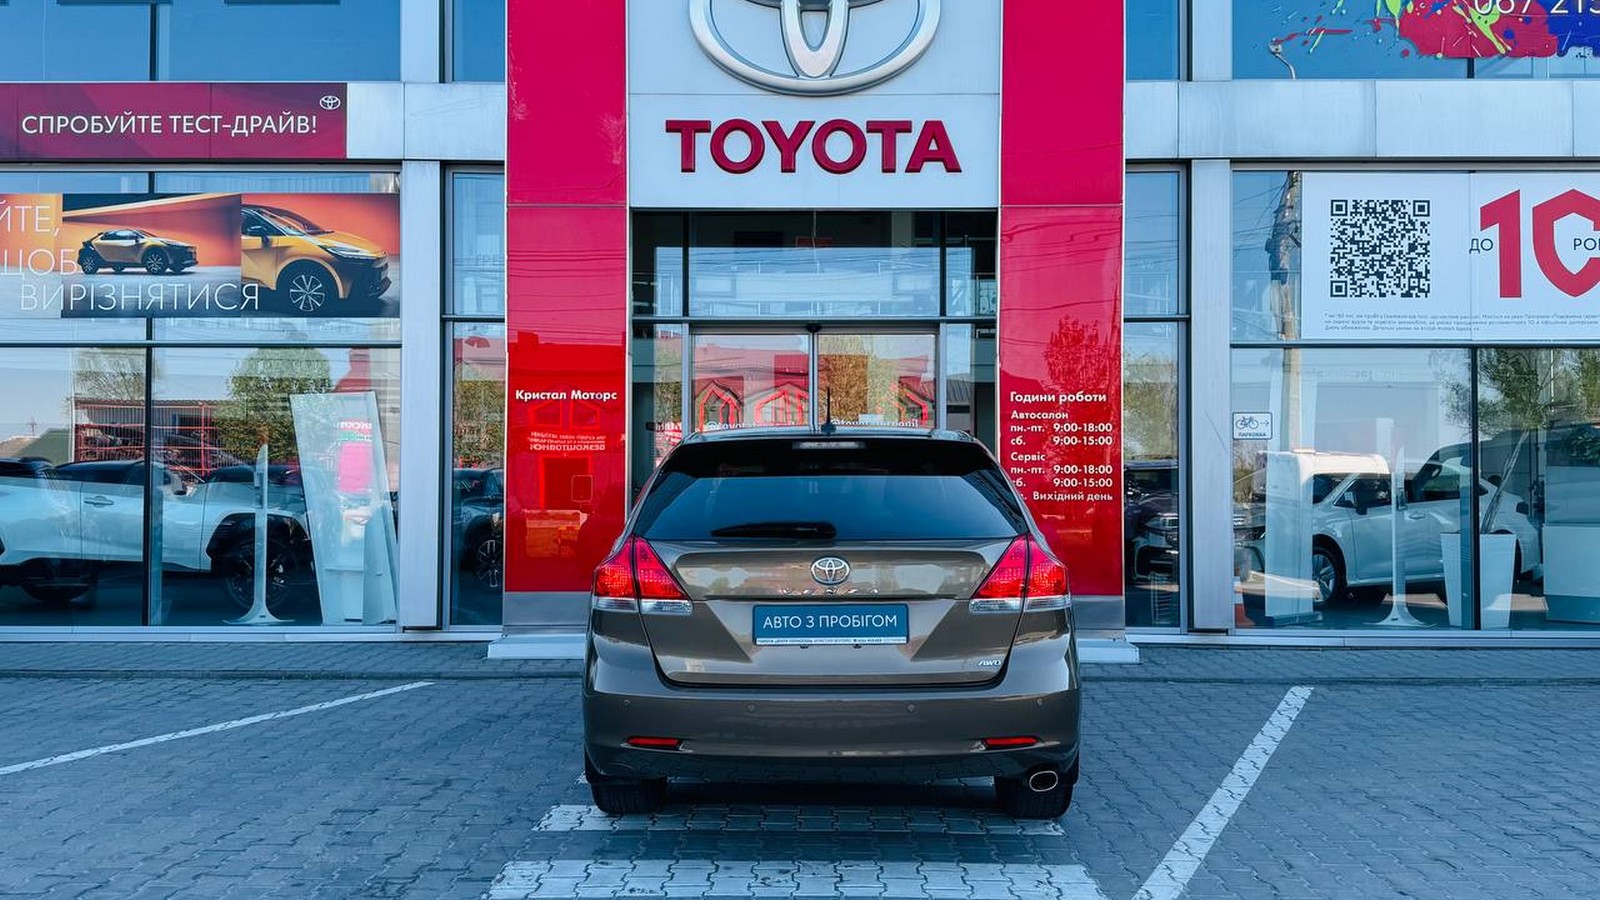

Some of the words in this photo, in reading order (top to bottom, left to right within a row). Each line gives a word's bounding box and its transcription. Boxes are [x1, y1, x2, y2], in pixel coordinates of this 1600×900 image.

[21, 111, 163, 134] СПРОБУЙТЕ
[169, 111, 317, 137] ТЕСТ-ДРАЙВ!
[665, 118, 962, 175] TOYOTA
[1468, 238, 1494, 254] ДО
[1573, 238, 1600, 251] РО
[0, 248, 77, 280] ЩОБ
[20, 283, 260, 311] ВИРІЗНЯТИСЯ
[515, 389, 567, 402] Кристал
[570, 389, 618, 402] Моторс
[1010, 391, 1056, 404] Години
[1059, 390, 1107, 405] роботи
[1010, 410, 1069, 420] Автосалон
[1010, 425, 1046, 433] пн.-пт.
[1053, 422, 1113, 433] 9:00-18:00
[1010, 436, 1026, 446] сб.
[1053, 436, 1113, 446] 9:00-15:00
[1010, 451, 1046, 463] Сервіс
[1010, 466, 1046, 474] пн.-пт.
[1053, 464, 1113, 475] 9:00-18:00
[1053, 477, 1113, 488] 9:00-15:00
[1033, 490, 1084, 502] Вихідний
[1087, 493, 1113, 502] день
[763, 615, 802, 629] АВТО
[819, 614, 897, 629] ПРОБІГОМ
